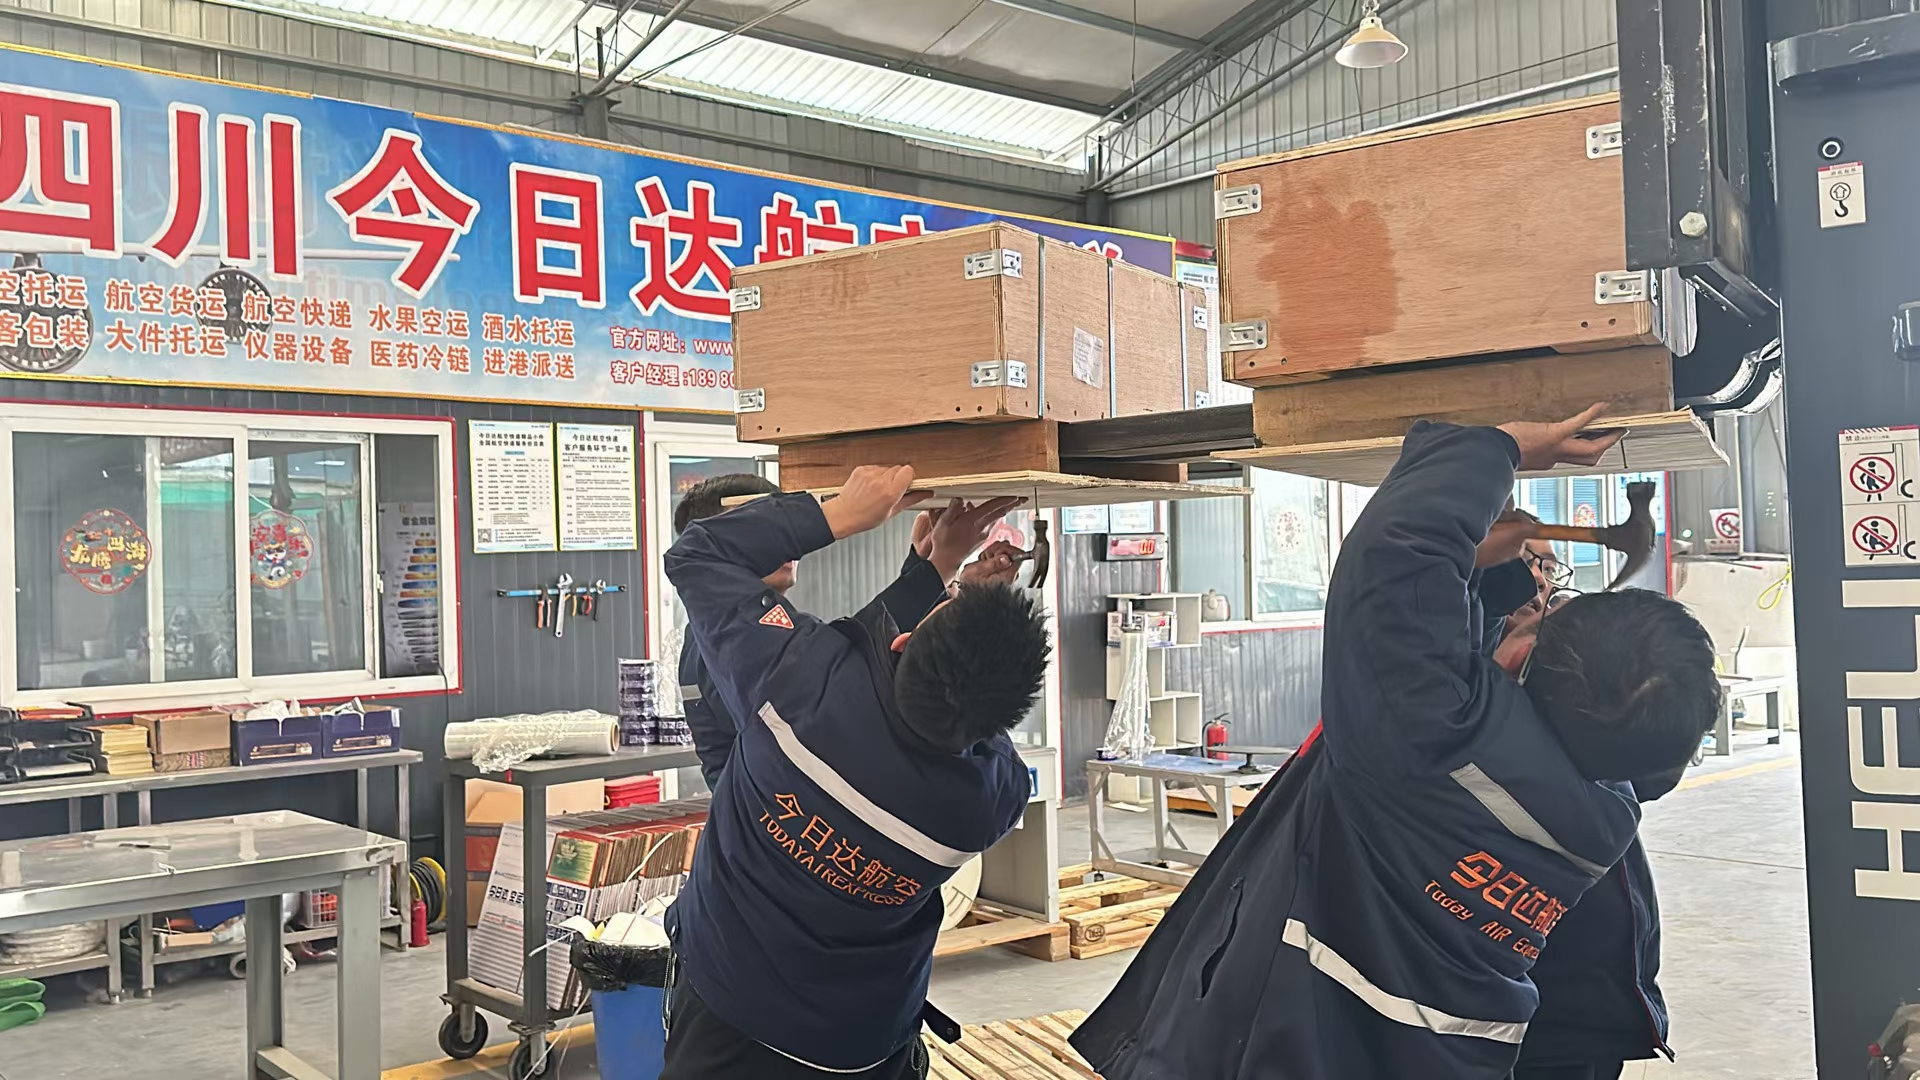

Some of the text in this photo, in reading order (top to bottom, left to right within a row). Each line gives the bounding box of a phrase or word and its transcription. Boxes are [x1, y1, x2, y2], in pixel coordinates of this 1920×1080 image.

[105, 279, 228, 321] 航空货运
[242, 290, 353, 329] 航空快递
[368, 304, 470, 339] 水果空运
[482, 312, 576, 347] 酒水托运
[105, 319, 229, 358] 大件托运
[243, 331, 353, 366] 仪器设备
[370, 340, 471, 375] 医药冷链
[483, 347, 576, 380] 进港派送
[1841, 579, 1920, 900] HELI
[774, 793, 922, 897] 今日达航空
[1425, 880, 1474, 921] Today
[1480, 921, 1512, 941] AIR
